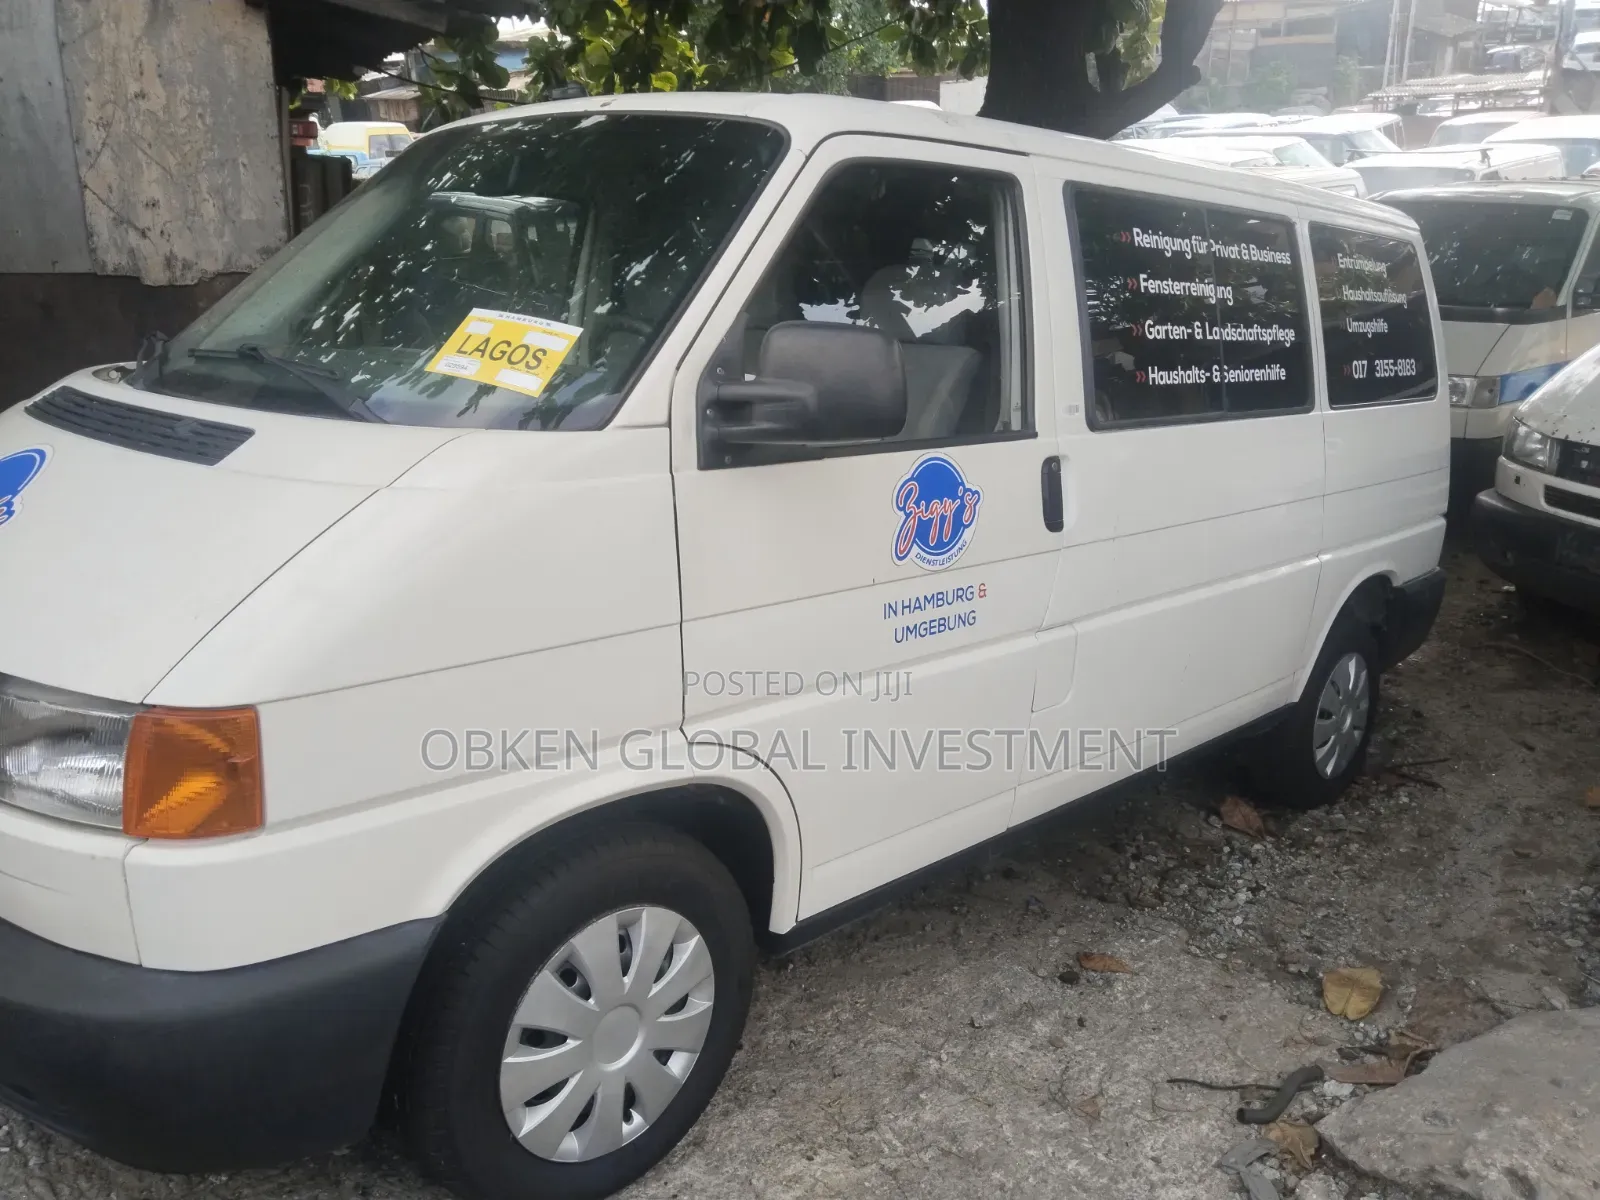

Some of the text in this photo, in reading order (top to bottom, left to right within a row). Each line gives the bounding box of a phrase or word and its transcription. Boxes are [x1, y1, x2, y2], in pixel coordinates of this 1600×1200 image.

[1132, 227, 1192, 259] Reinigung
[1192, 235, 1208, 253] für
[1241, 243, 1250, 260] &
[1250, 244, 1292, 265] Business
[1342, 284, 1408, 309] Haushaltsauflösung
[1144, 319, 1296, 347] Garten- & Landschaftspflege
[1346, 317, 1388, 338] Umzugshilfe
[456, 334, 548, 370] LAGOS
[1148, 363, 1286, 385] Haushalts- & Seniorenhilfe
[1352, 358, 1416, 379] 017 3155-8183
[914, 540, 967, 566] DIENSTLEISTUNG
[883, 583, 987, 620] IN HAMBURG &
[894, 610, 977, 643] UMGEBUNG
